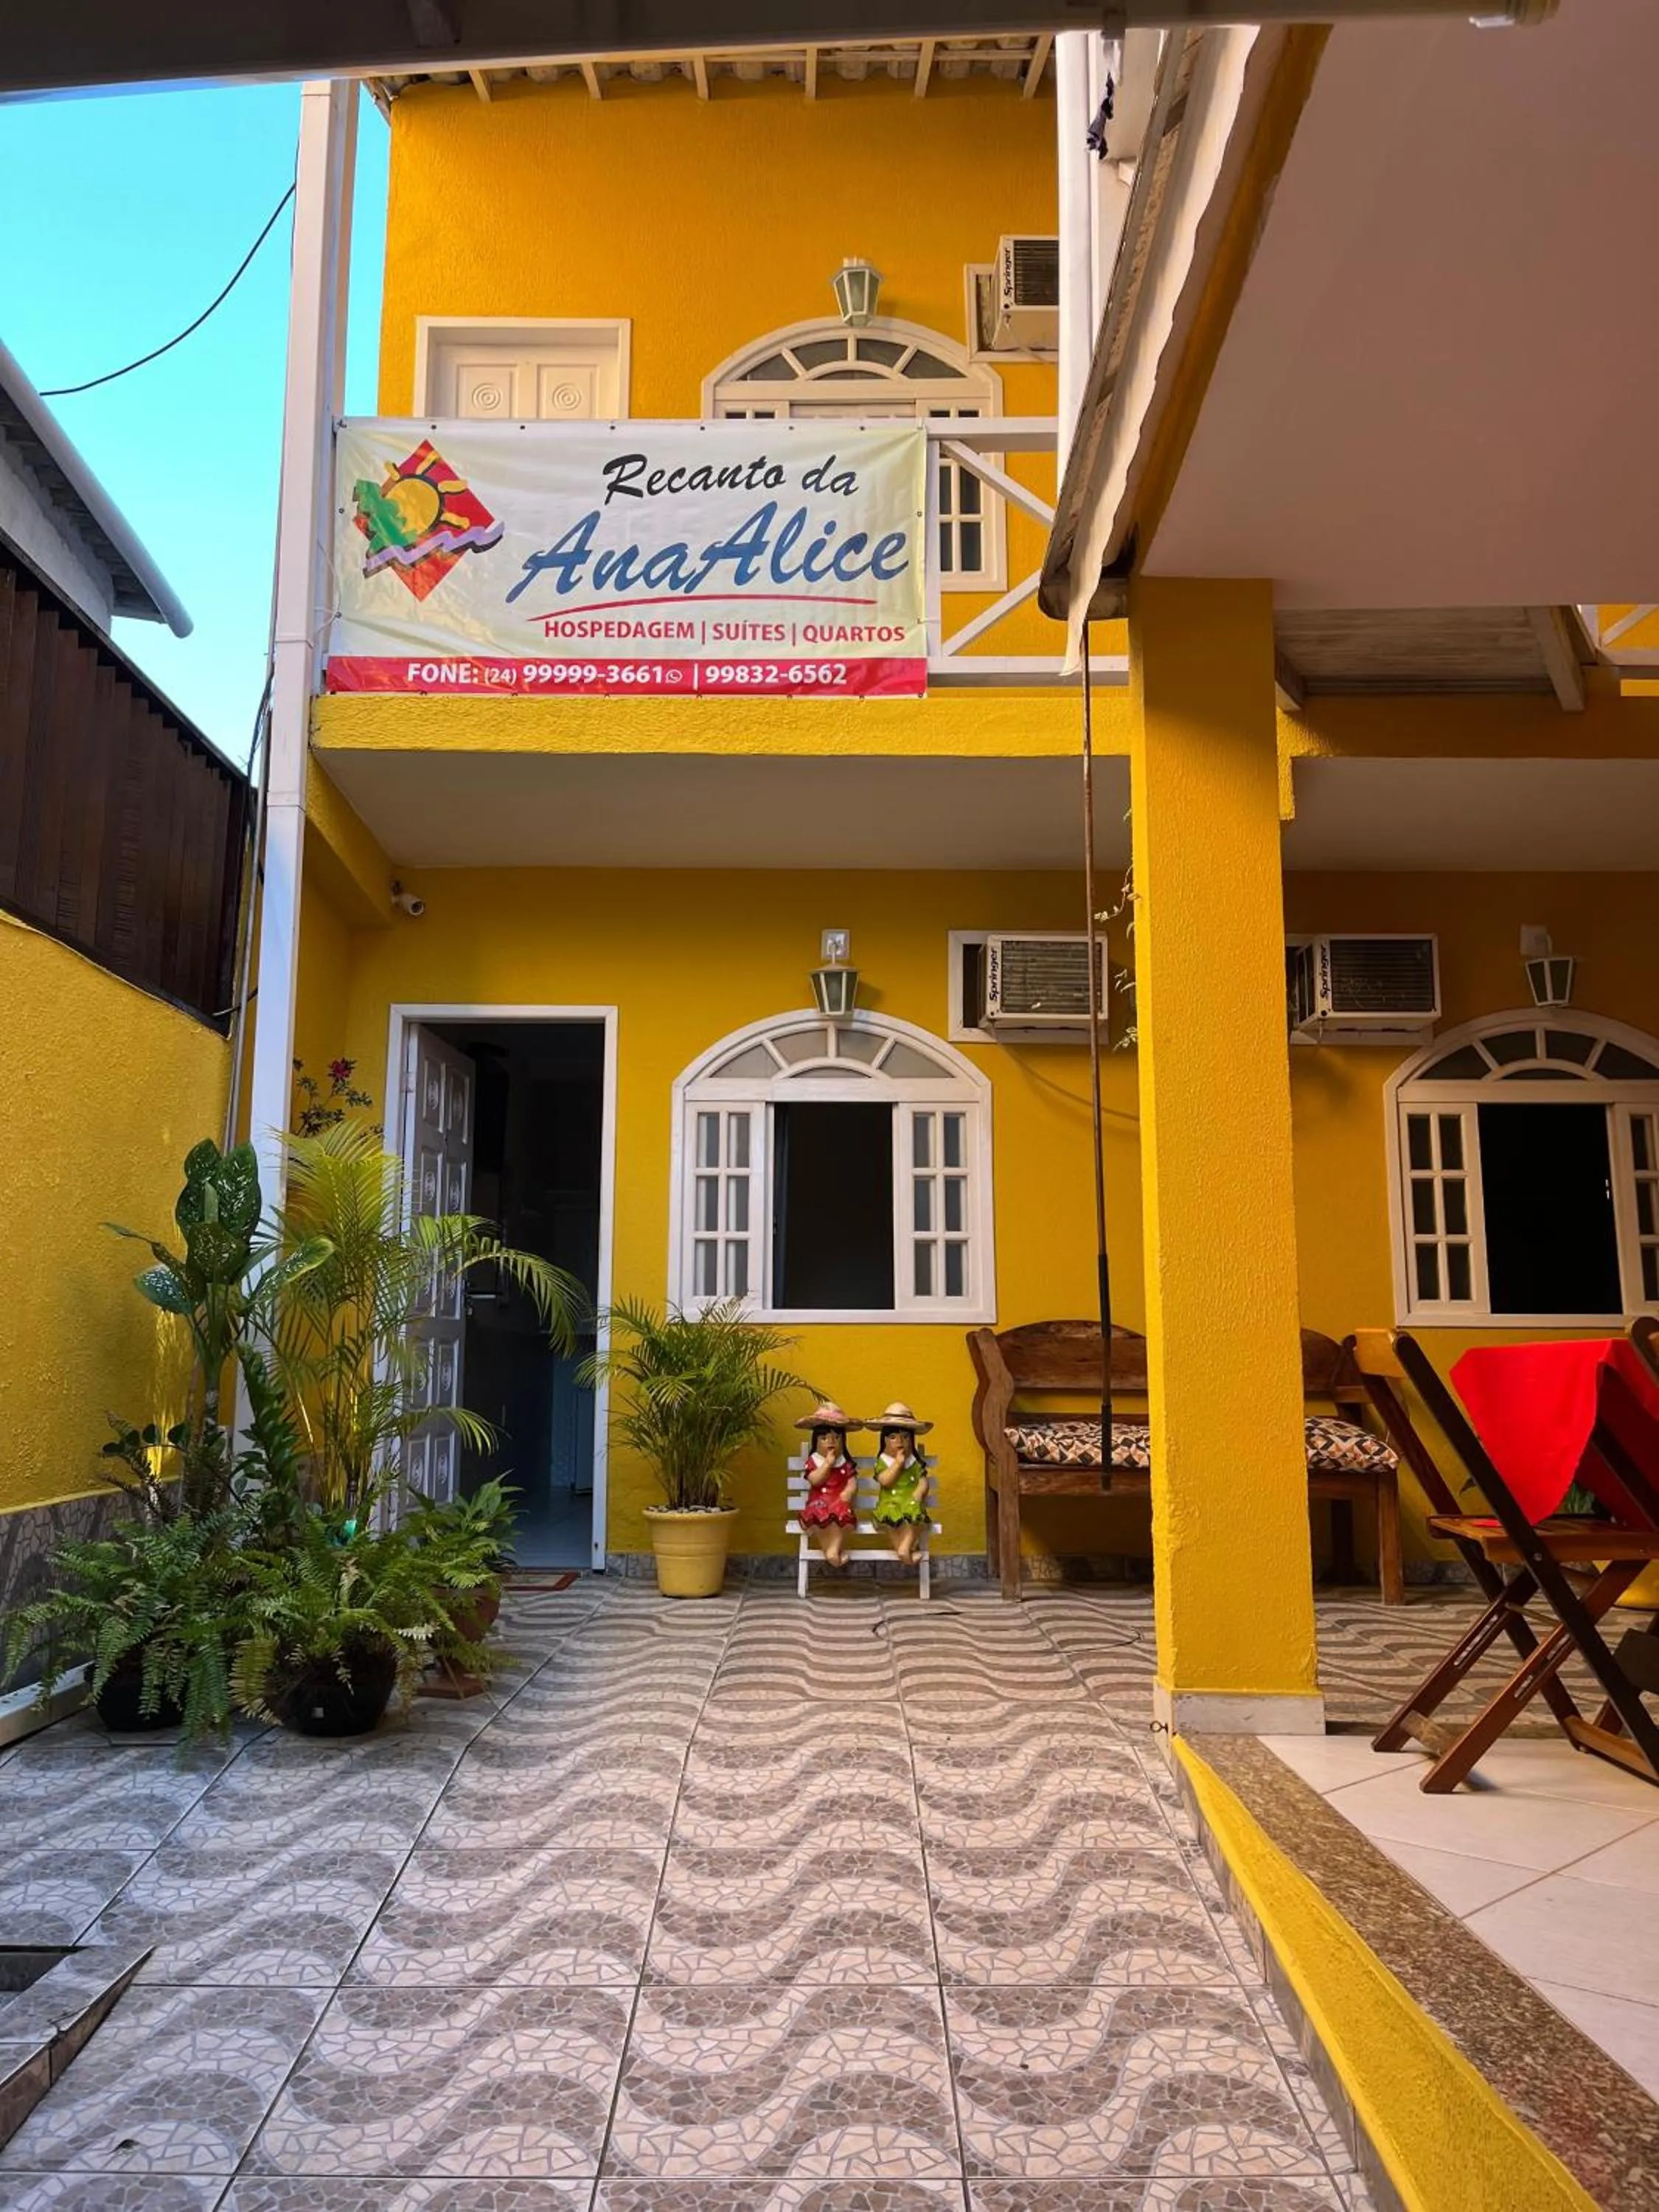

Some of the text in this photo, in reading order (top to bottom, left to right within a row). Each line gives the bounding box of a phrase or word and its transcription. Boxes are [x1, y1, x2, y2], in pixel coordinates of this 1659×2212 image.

[1004, 248, 1014, 296] Springer
[602, 453, 860, 505] Recanto da
[505, 501, 909, 603] AnaAlice
[544, 620, 905, 643] HOSPEDAGEM SUÍTES QUARTOS
[407, 663, 847, 685] FONE: (24) 99999-3661 99832-6562
[989, 948, 1000, 1001] Springer
[1320, 943, 1331, 999] Springer
